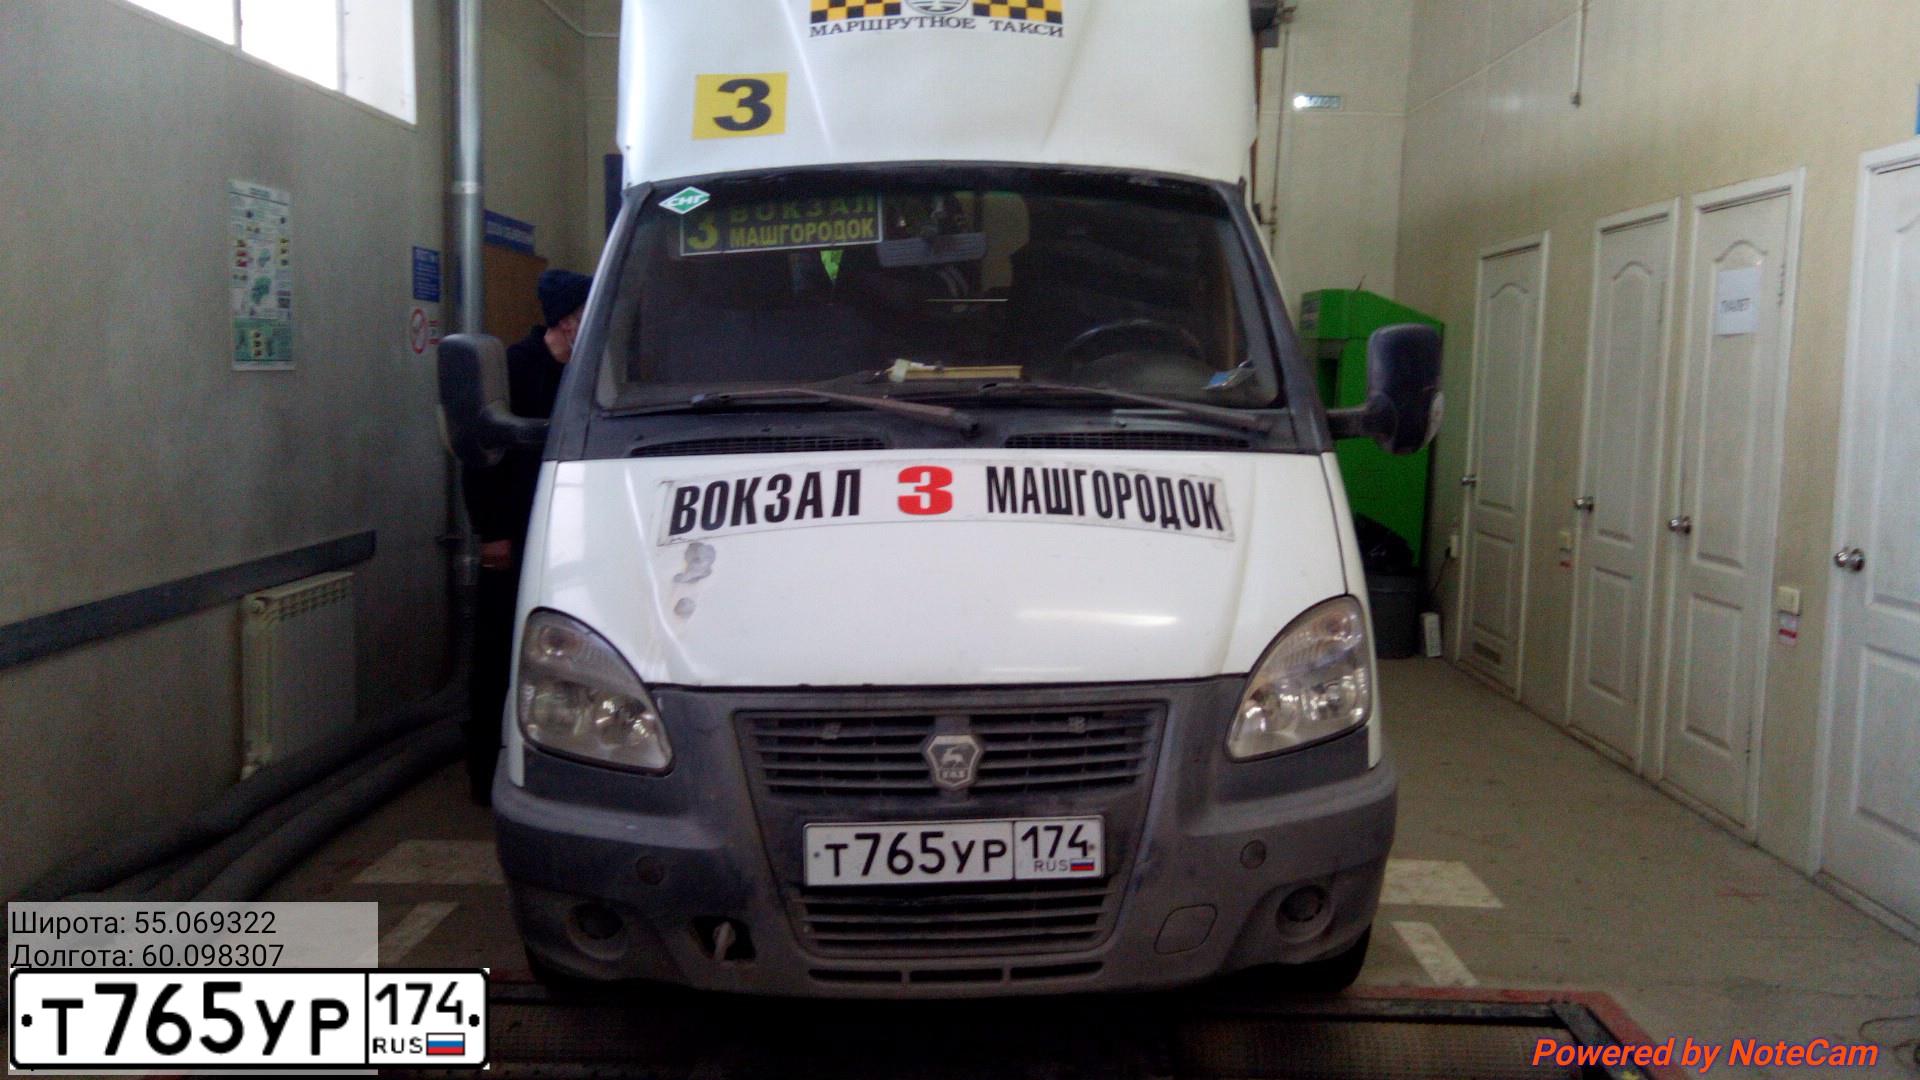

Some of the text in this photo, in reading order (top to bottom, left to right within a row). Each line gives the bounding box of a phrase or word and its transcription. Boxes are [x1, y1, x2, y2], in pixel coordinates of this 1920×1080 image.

[809, 16, 1065, 38] МАРШРУТНОЕ ТАКСИ
[713, 78, 772, 131] 3
[729, 217, 875, 248] МАШГОРОДОК
[668, 465, 1223, 536] ВОКЗАЛ 3 МАШГОРОДОК
[824, 824, 1089, 877] Т765УР 174
[1034, 858, 1069, 873] RUS
